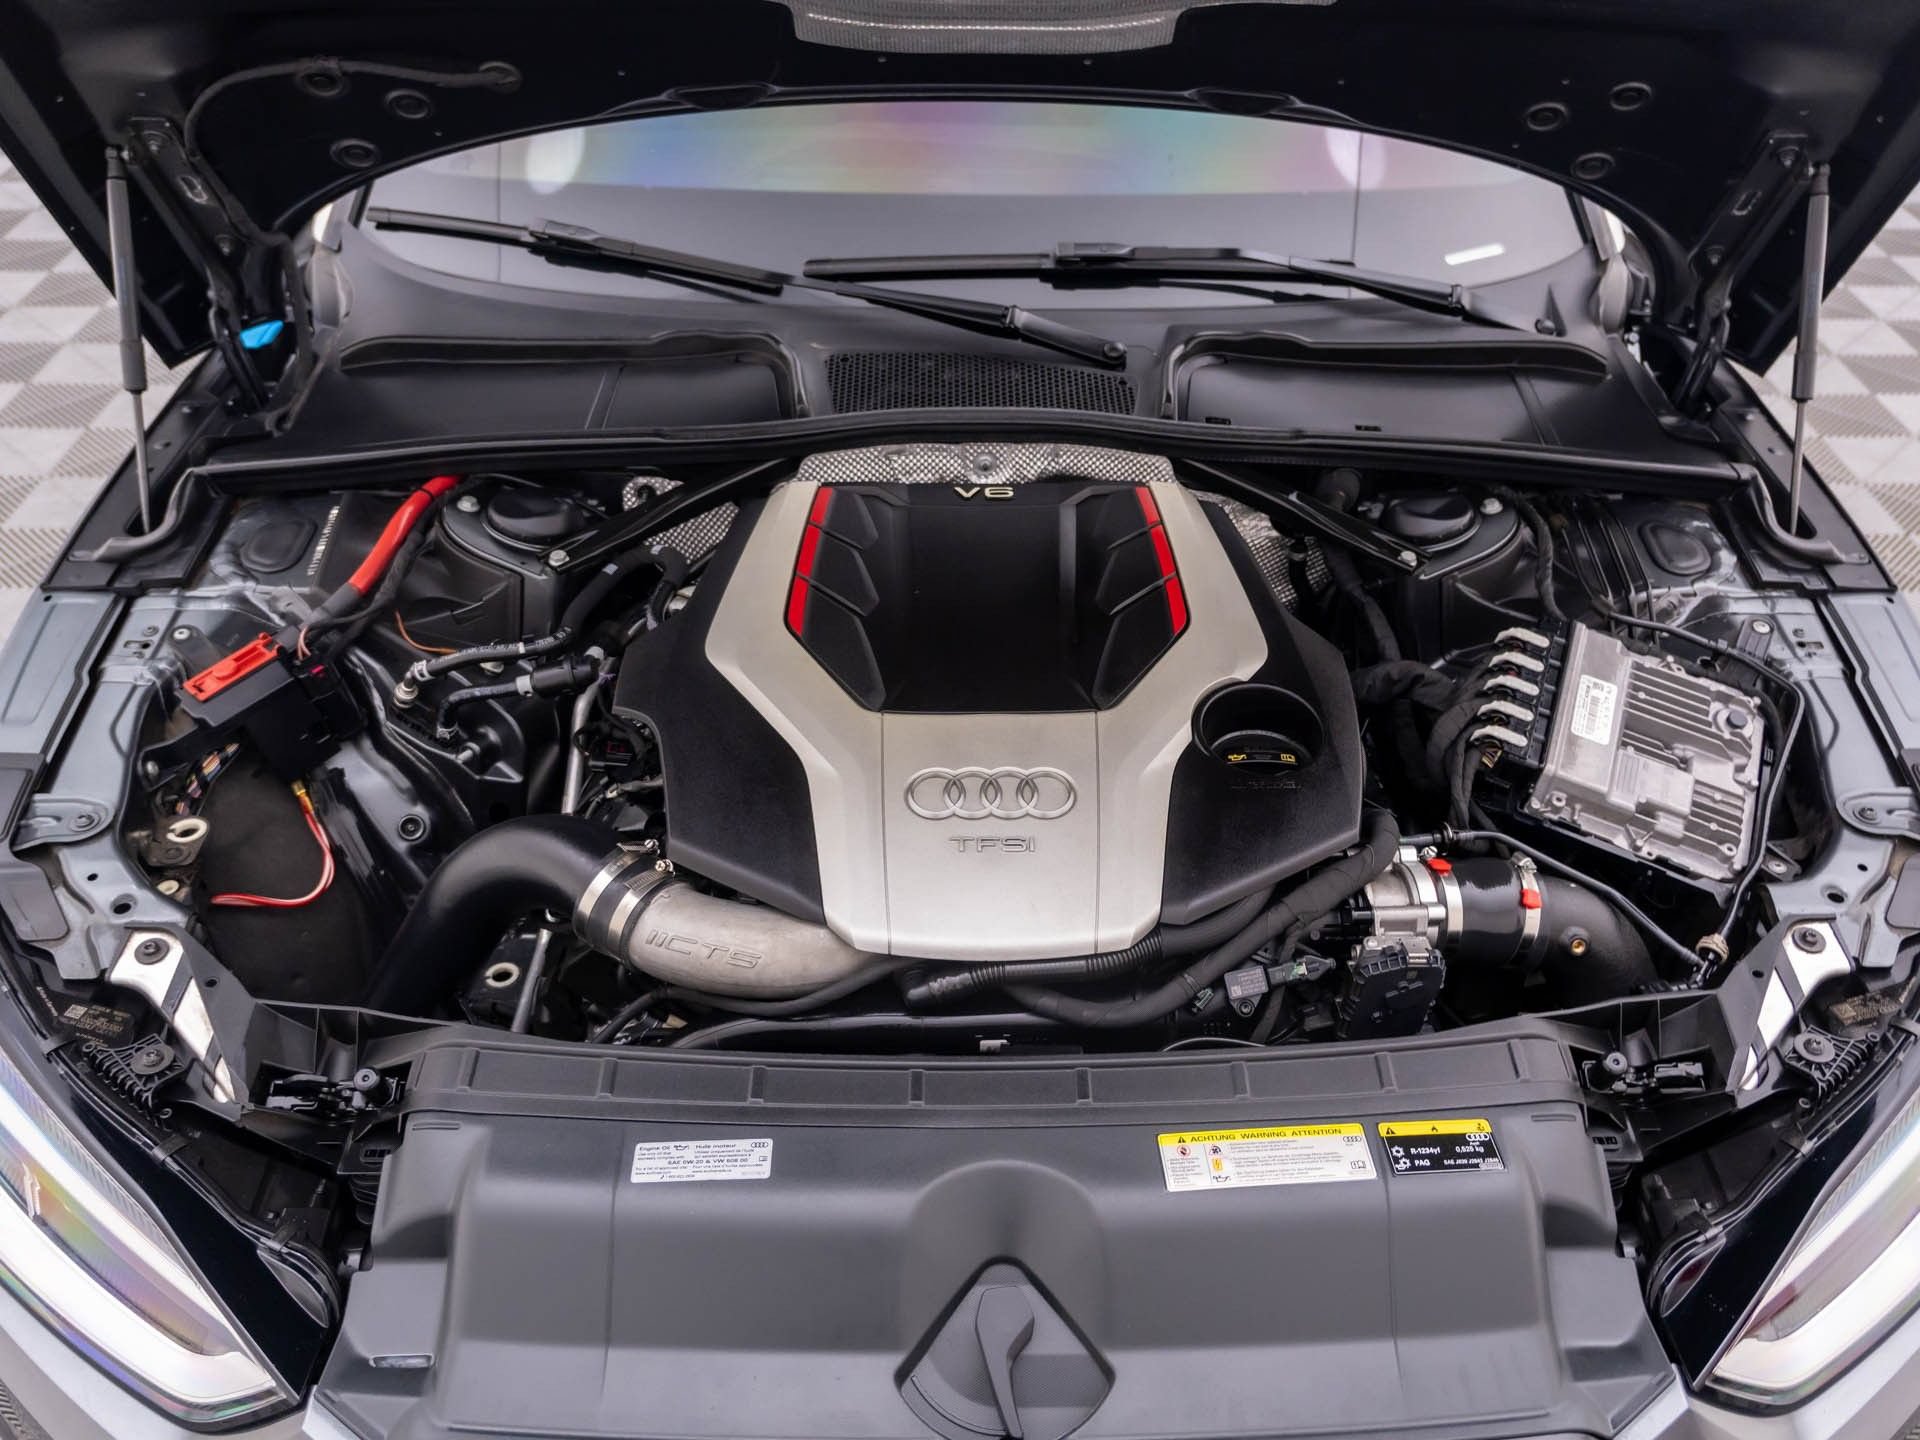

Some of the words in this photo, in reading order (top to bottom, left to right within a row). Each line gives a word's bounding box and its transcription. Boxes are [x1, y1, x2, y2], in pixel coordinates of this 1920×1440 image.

[954, 486, 1014, 498] V6
[949, 836, 1036, 853] TFSI
[664, 933, 762, 969] CTS
[1190, 1134, 1236, 1142] ACHTUNG
[1240, 1131, 1287, 1140] WARNING
[1291, 1128, 1342, 1136] ATTENTION
[1475, 1145, 1485, 1153] kg
[1414, 1158, 1430, 1167] PAG
